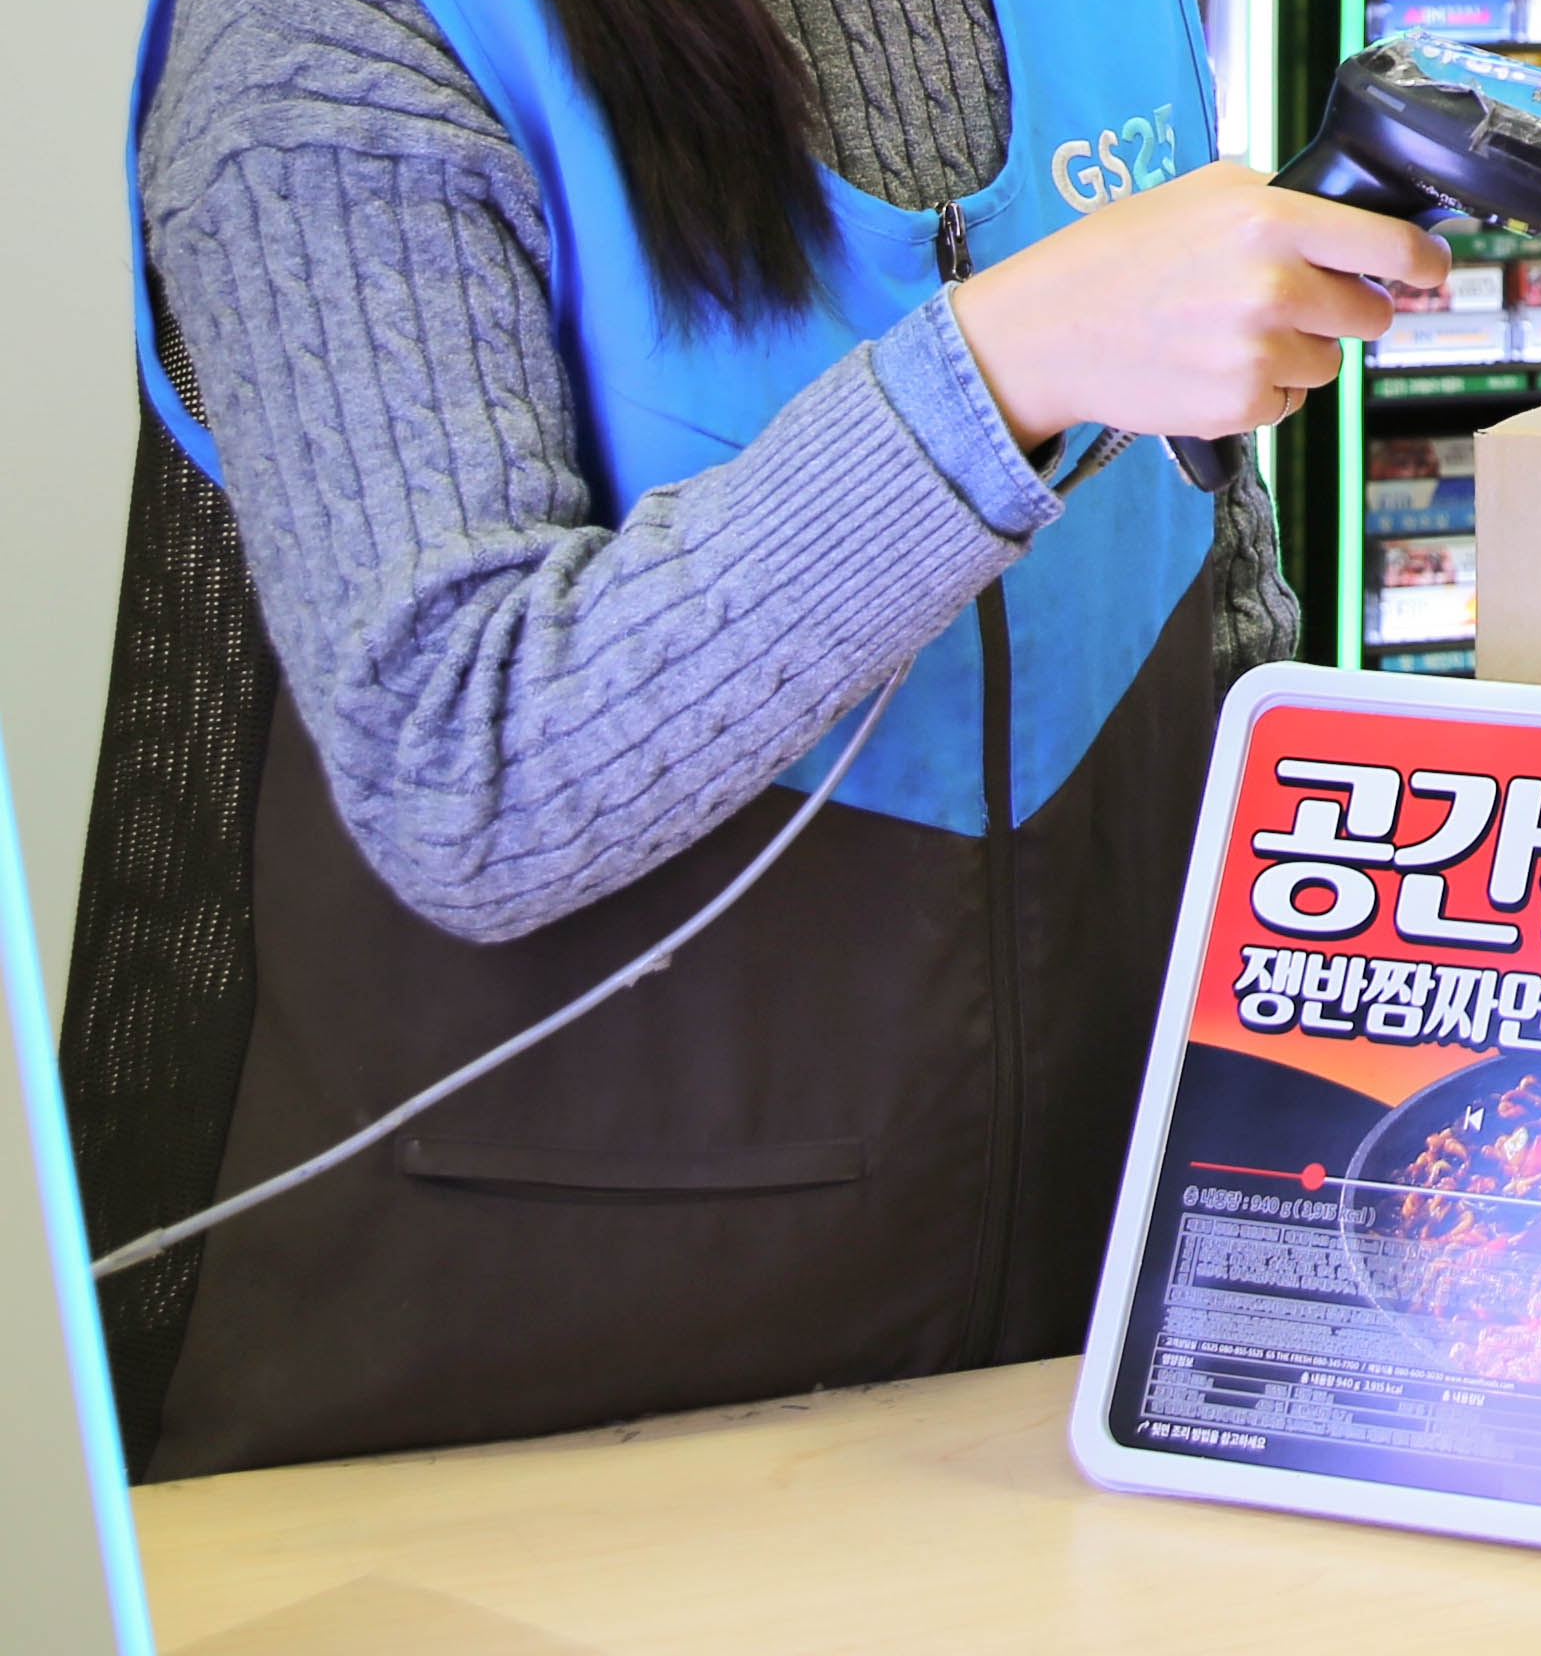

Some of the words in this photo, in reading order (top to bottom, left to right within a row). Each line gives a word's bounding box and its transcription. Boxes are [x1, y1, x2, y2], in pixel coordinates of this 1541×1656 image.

[1052, 103, 1176, 214] GS25
[1200, 1188, 1242, 1211] 내용량
[1250, 1196, 1280, 1215] 940
[1290, 1352, 1313, 1365] FRESH
[1335, 1375, 1353, 1390] 940
[1385, 1382, 1404, 1395] kcal
[1172, 1425, 1190, 1440] 조리
[1221, 1430, 1266, 1449] 참고하세요
